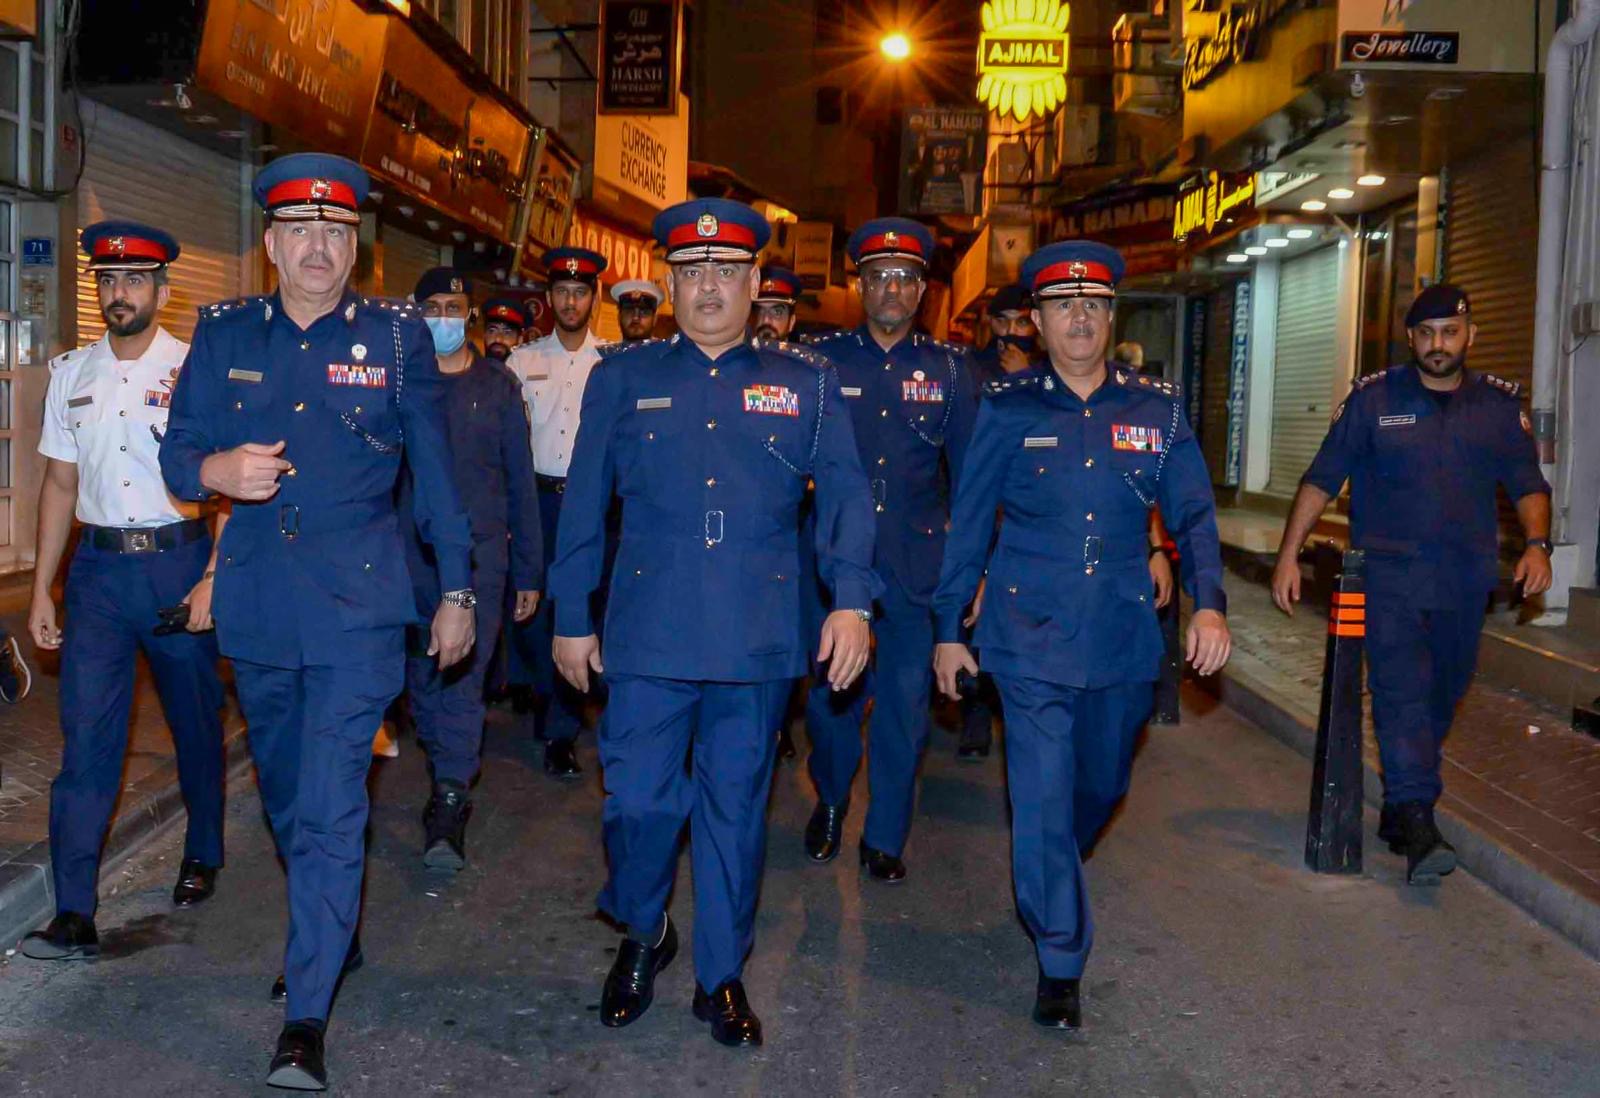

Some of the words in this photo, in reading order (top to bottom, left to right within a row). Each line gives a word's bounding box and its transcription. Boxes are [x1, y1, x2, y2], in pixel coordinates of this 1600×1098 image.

[261, 43, 297, 82] NASR
[988, 42, 1060, 63] AJMAL
[611, 66, 662, 80] HARSH
[621, 121, 667, 171] CURRENCY
[620, 150, 667, 200] EXCHANGE
[1173, 186, 1205, 239] AJMAL
[31, 242, 43, 252] 71
